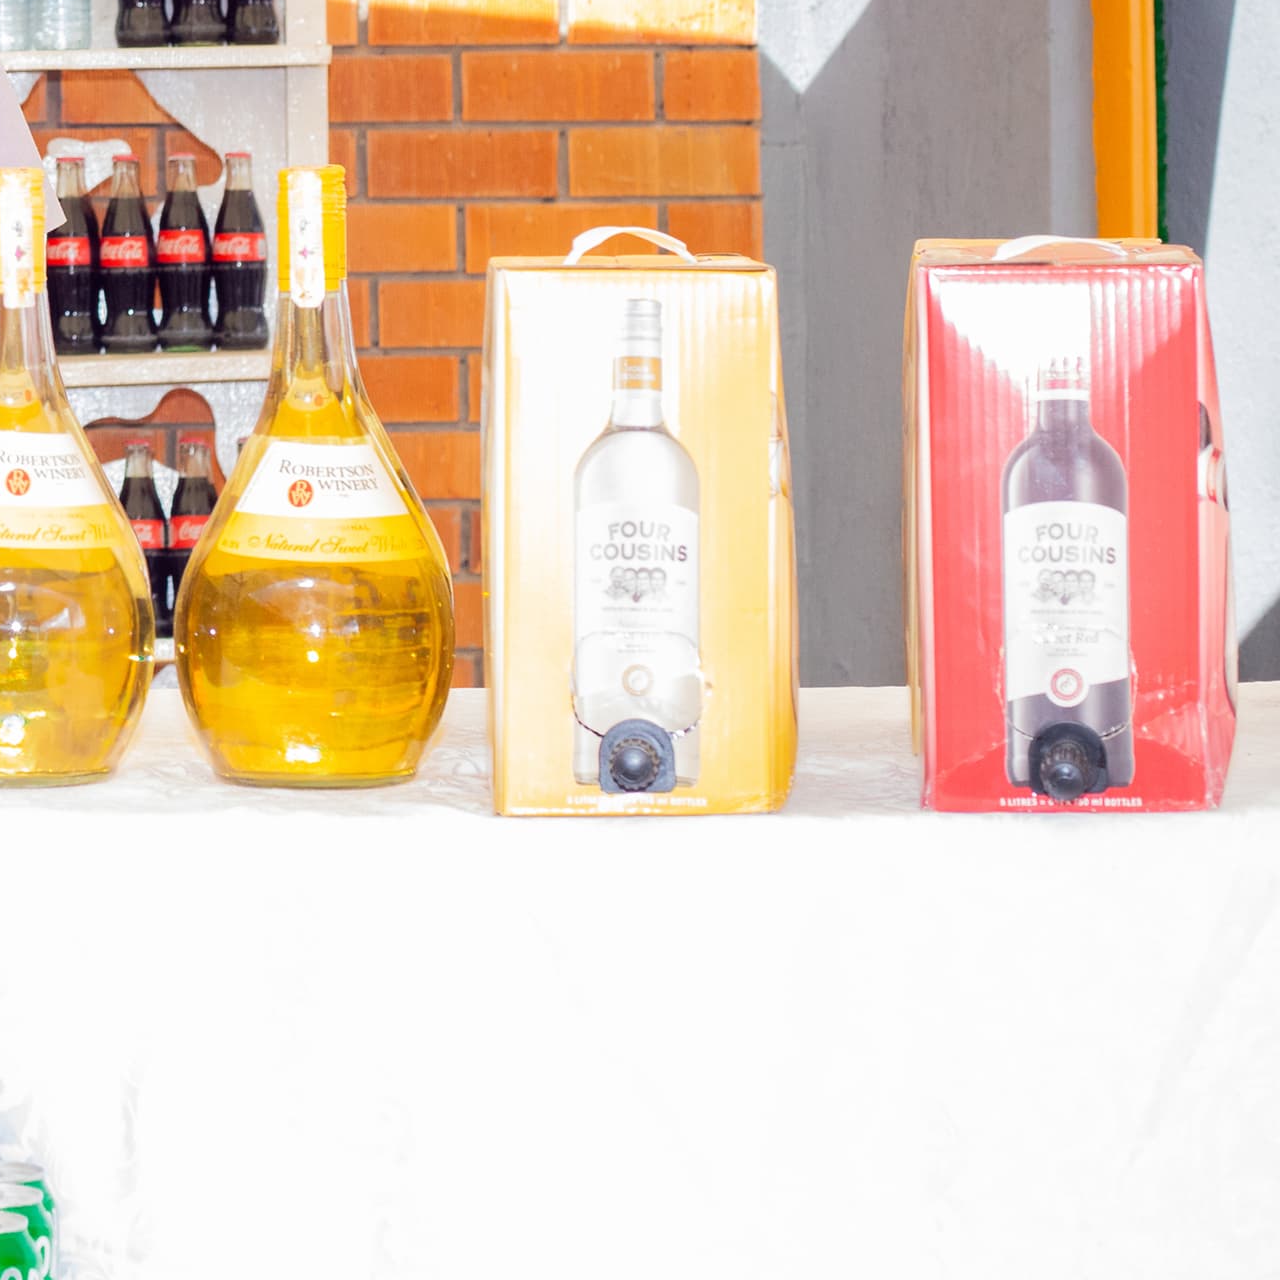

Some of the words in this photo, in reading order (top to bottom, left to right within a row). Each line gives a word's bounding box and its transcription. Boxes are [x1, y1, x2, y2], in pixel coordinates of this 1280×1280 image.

[33, 467, 86, 481] WINERY
[279, 459, 374, 476] ROBERTSON
[317, 478, 379, 492] WINERY
[42, 523, 87, 541] Sweet
[608, 520, 671, 542] FOUR
[1035, 522, 1099, 544] FOUR
[248, 532, 321, 553] Natural
[320, 534, 369, 554] Sweet
[590, 543, 688, 562] COUSINS
[1018, 545, 1116, 564] COUSINS
[1104, 797, 1143, 808] BOTTLES
